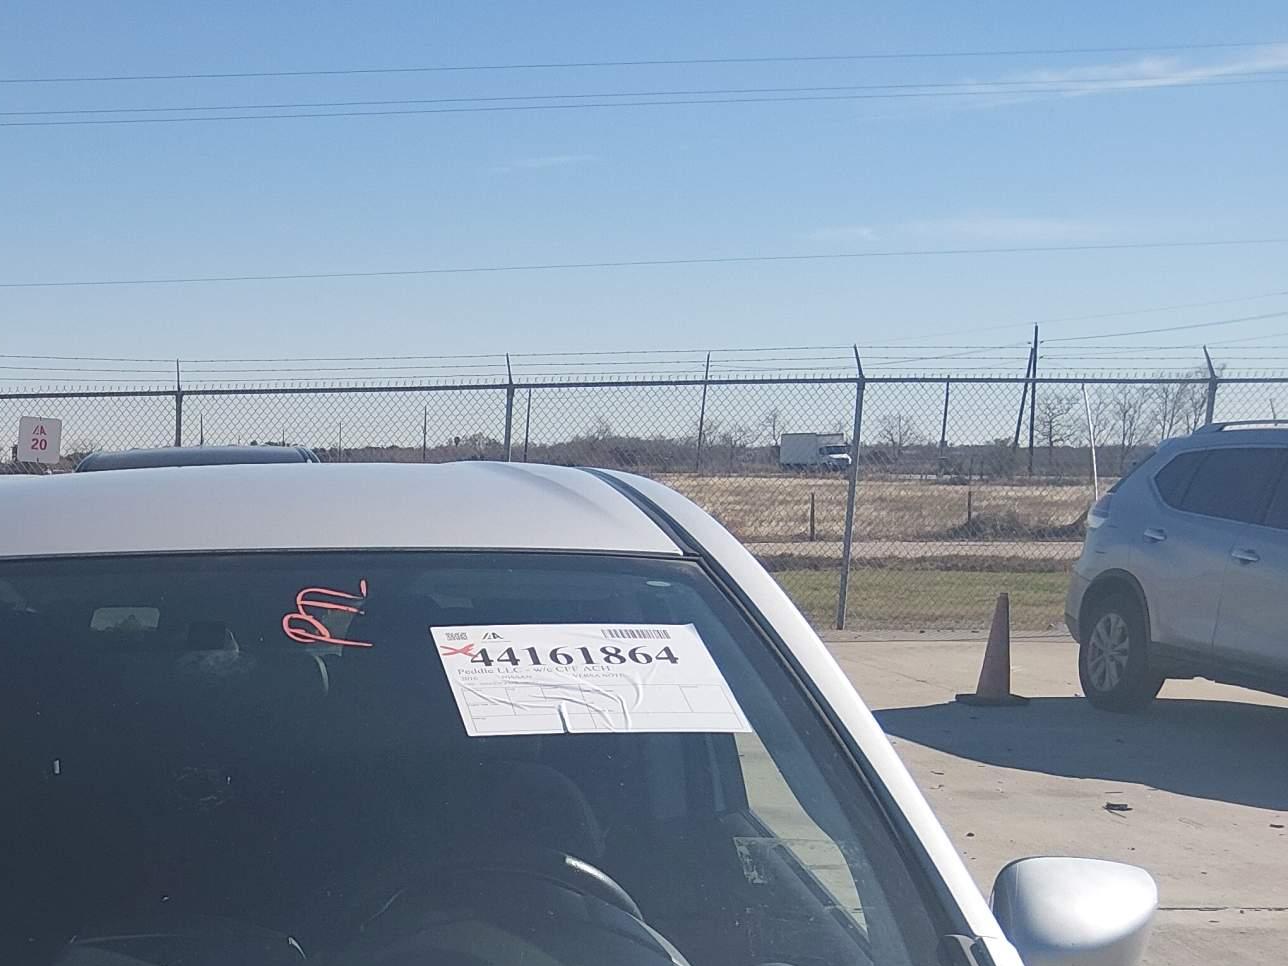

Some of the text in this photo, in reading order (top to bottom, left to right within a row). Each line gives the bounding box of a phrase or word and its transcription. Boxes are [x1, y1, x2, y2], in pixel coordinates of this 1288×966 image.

[31, 438, 47, 450] 20
[470, 645, 679, 667] 44161864
[457, 666, 495, 676] Peddle
[497, 666, 521, 674] LLC
